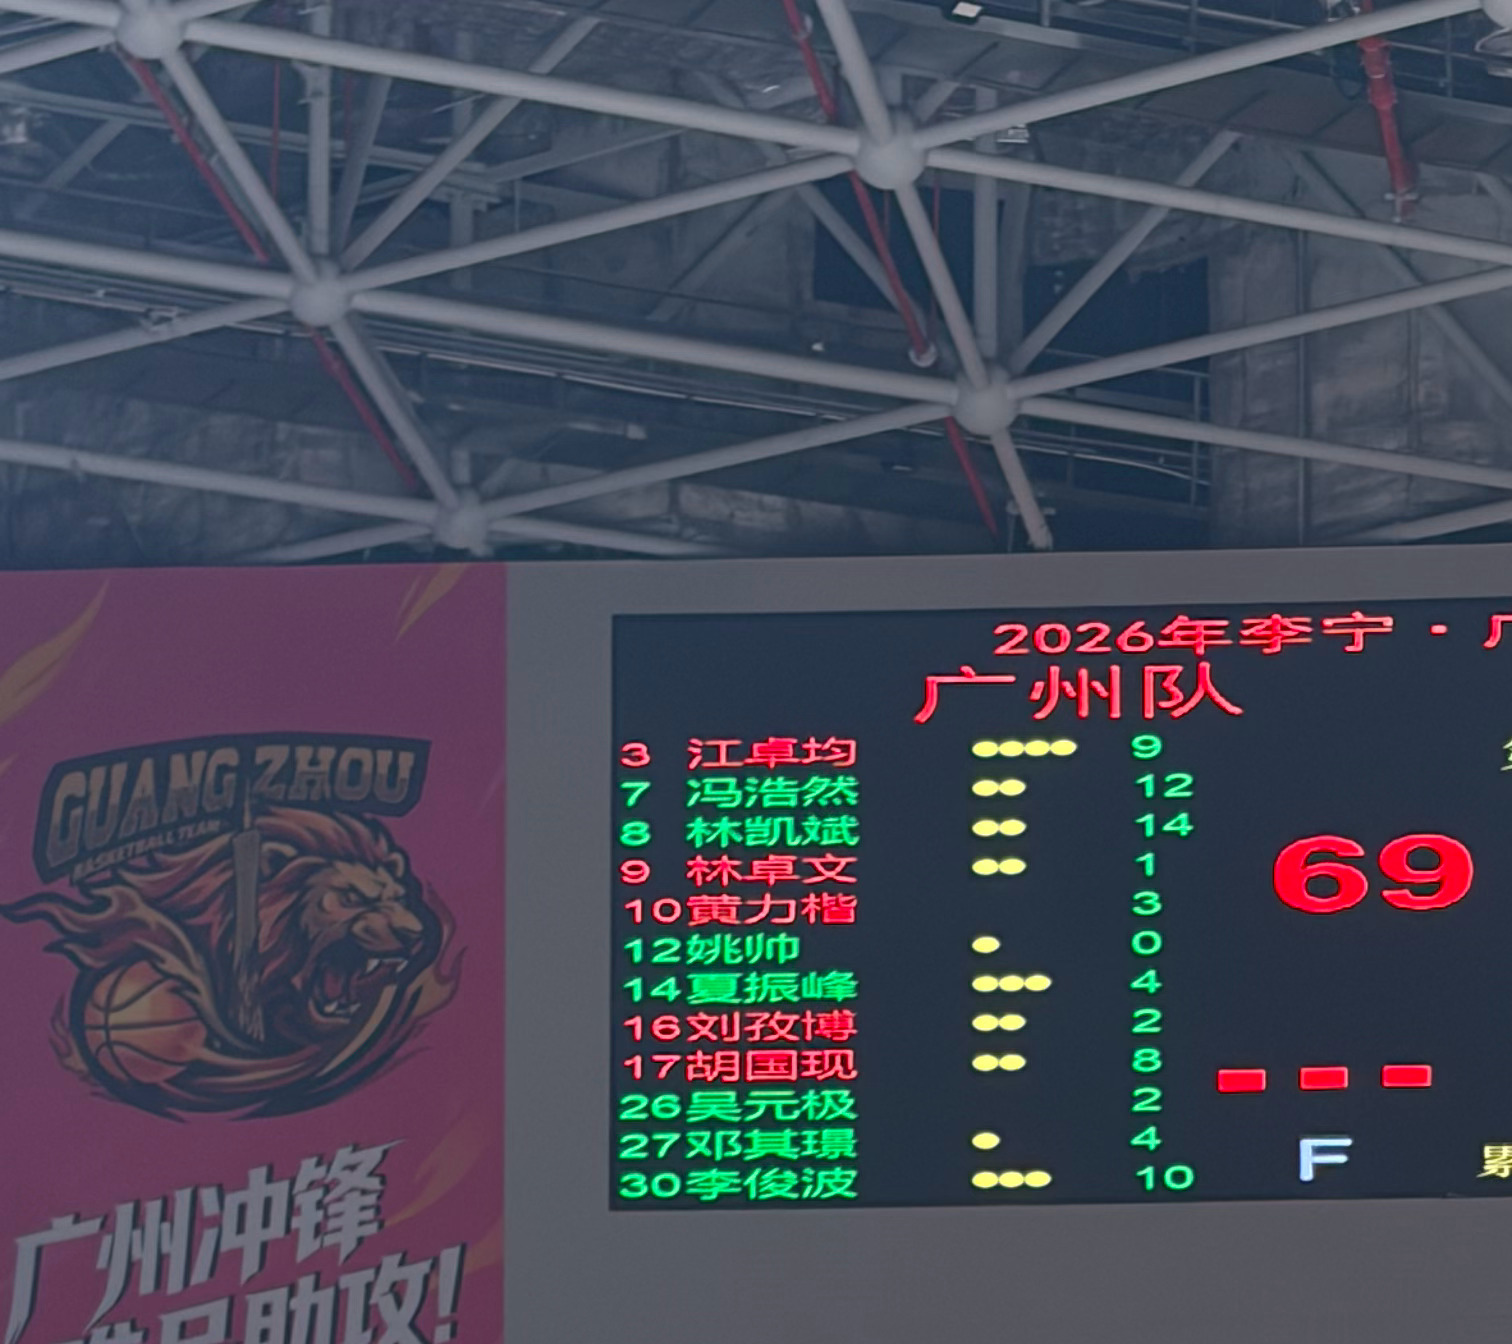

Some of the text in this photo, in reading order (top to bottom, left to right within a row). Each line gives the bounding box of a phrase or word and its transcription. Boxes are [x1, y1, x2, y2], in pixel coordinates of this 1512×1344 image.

[913, 661, 1244, 724] 广州队
[620, 734, 1162, 770] 3 江卓均 9
[46, 746, 416, 869] GUANG ZHOU
[620, 772, 1193, 809] 7 冯浩然 12
[619, 812, 1194, 849] 8 林凯斌 14
[619, 852, 1154, 887] 9 林卓文 1
[1273, 833, 1475, 913] 69
[624, 890, 1162, 927] 10 黄力楷 3
[623, 930, 1162, 965] 12 姚帅 0
[623, 969, 1162, 1005] 14 夏振峰 4
[623, 1015, 681, 1041] 16
[1131, 1007, 1162, 1034] 2
[623, 1047, 1162, 1083] 17 胡国现 8
[619, 1086, 1162, 1123] 26 吴元极 2
[619, 1132, 681, 1159] 27
[1130, 1126, 1162, 1151] 4
[1299, 1137, 1353, 1182] F
[619, 1164, 1195, 1201] 30 李俊波 10
